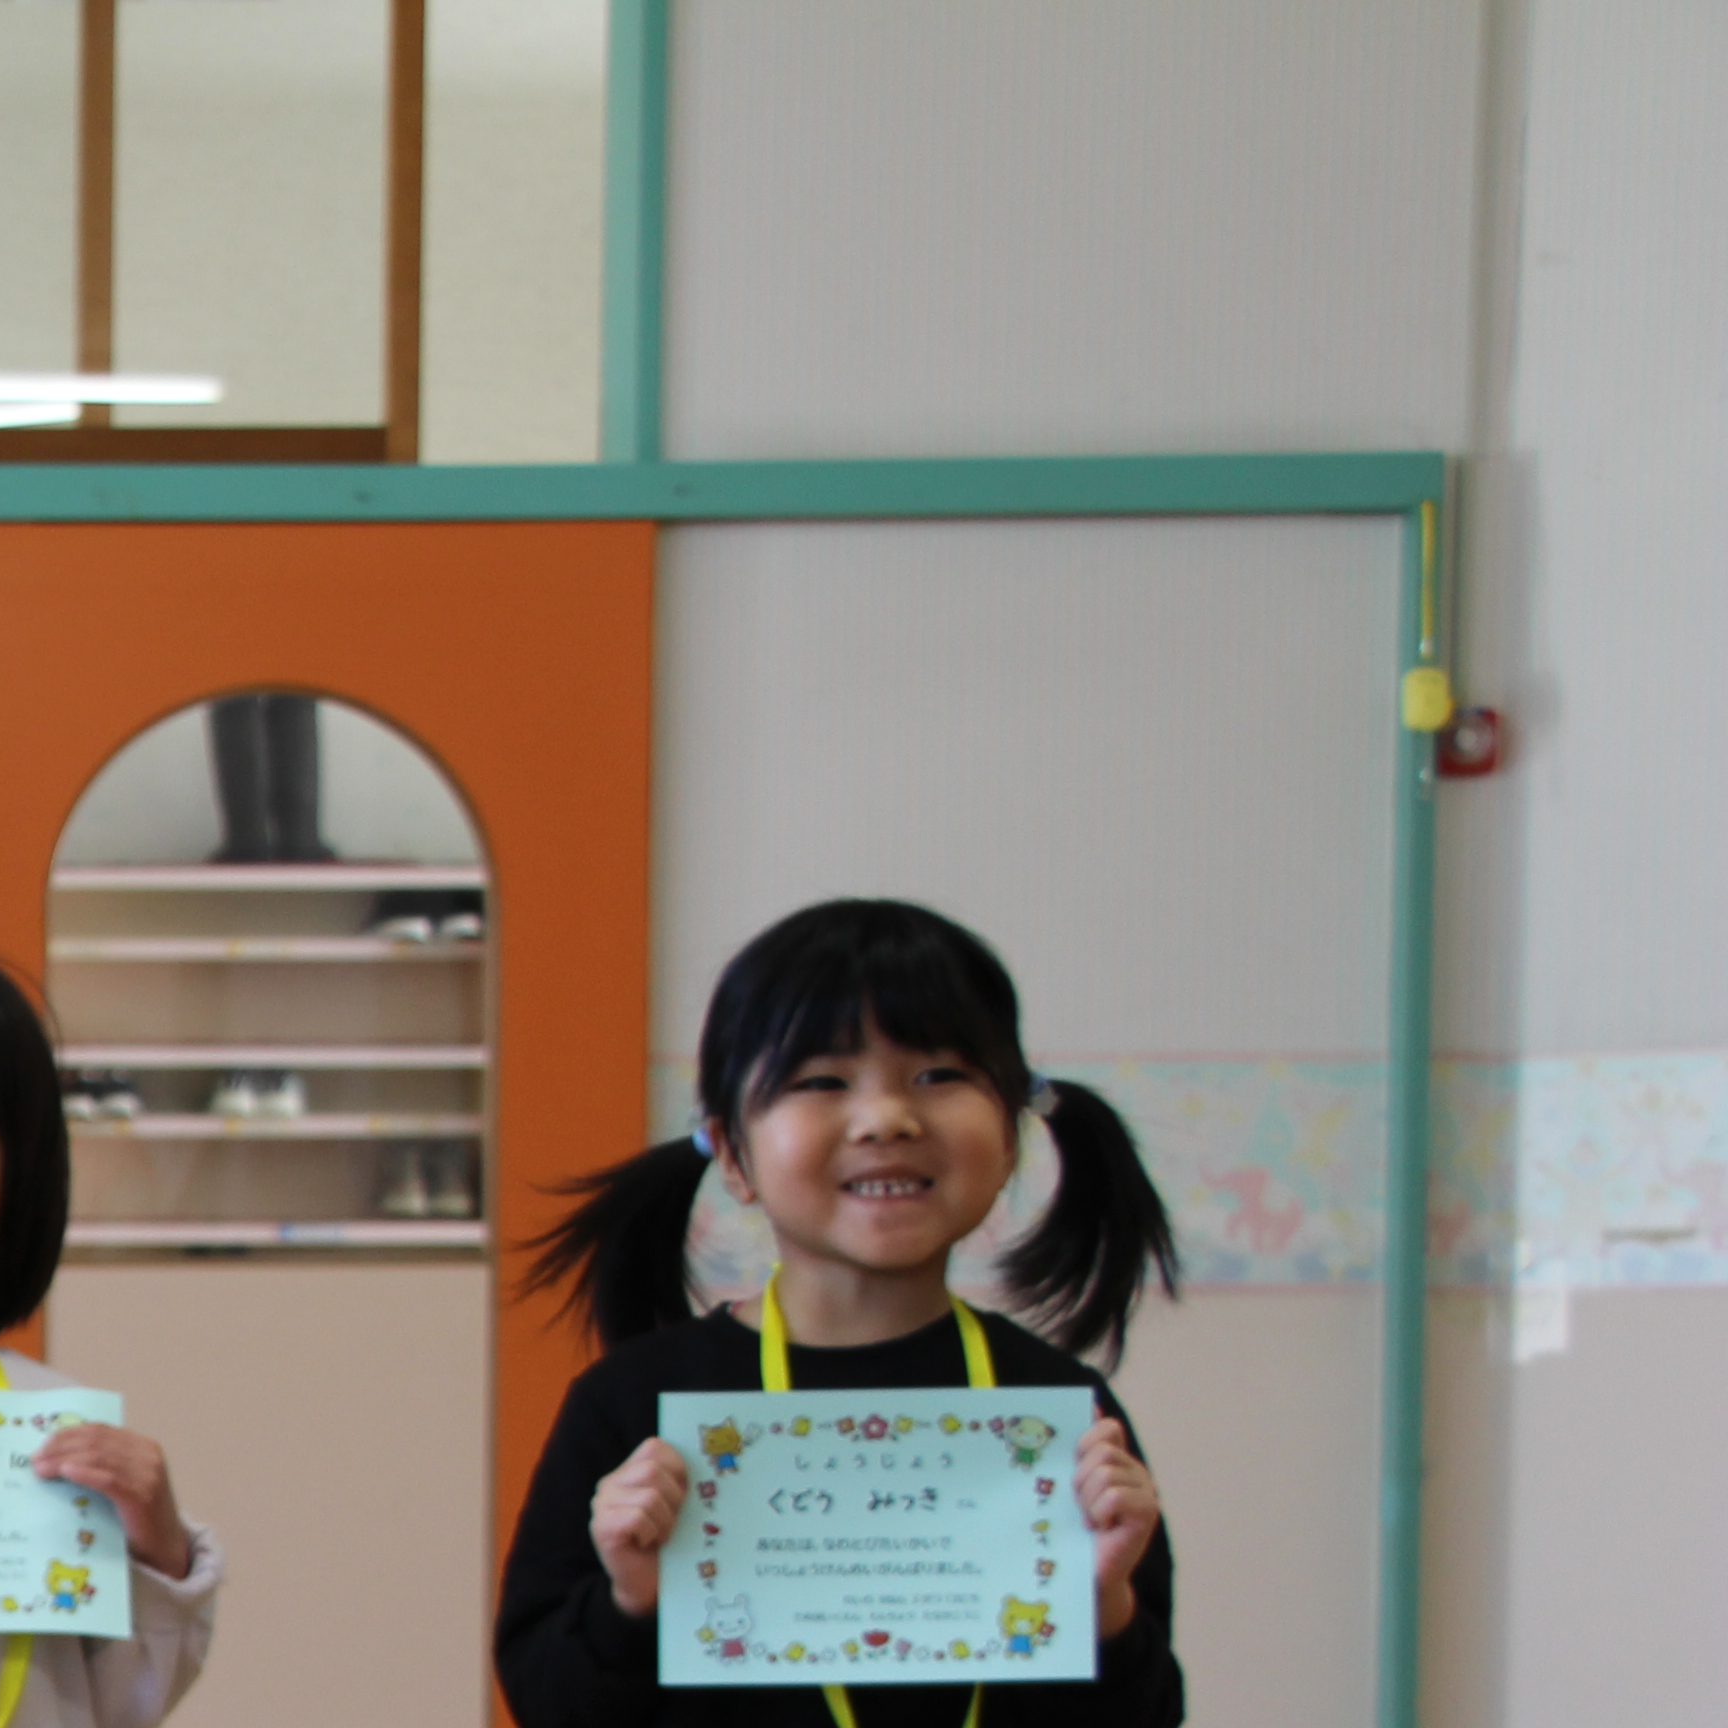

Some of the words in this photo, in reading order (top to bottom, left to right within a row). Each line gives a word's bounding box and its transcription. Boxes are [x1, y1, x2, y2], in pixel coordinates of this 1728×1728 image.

[795, 1452, 953, 1471] しょうじょう
